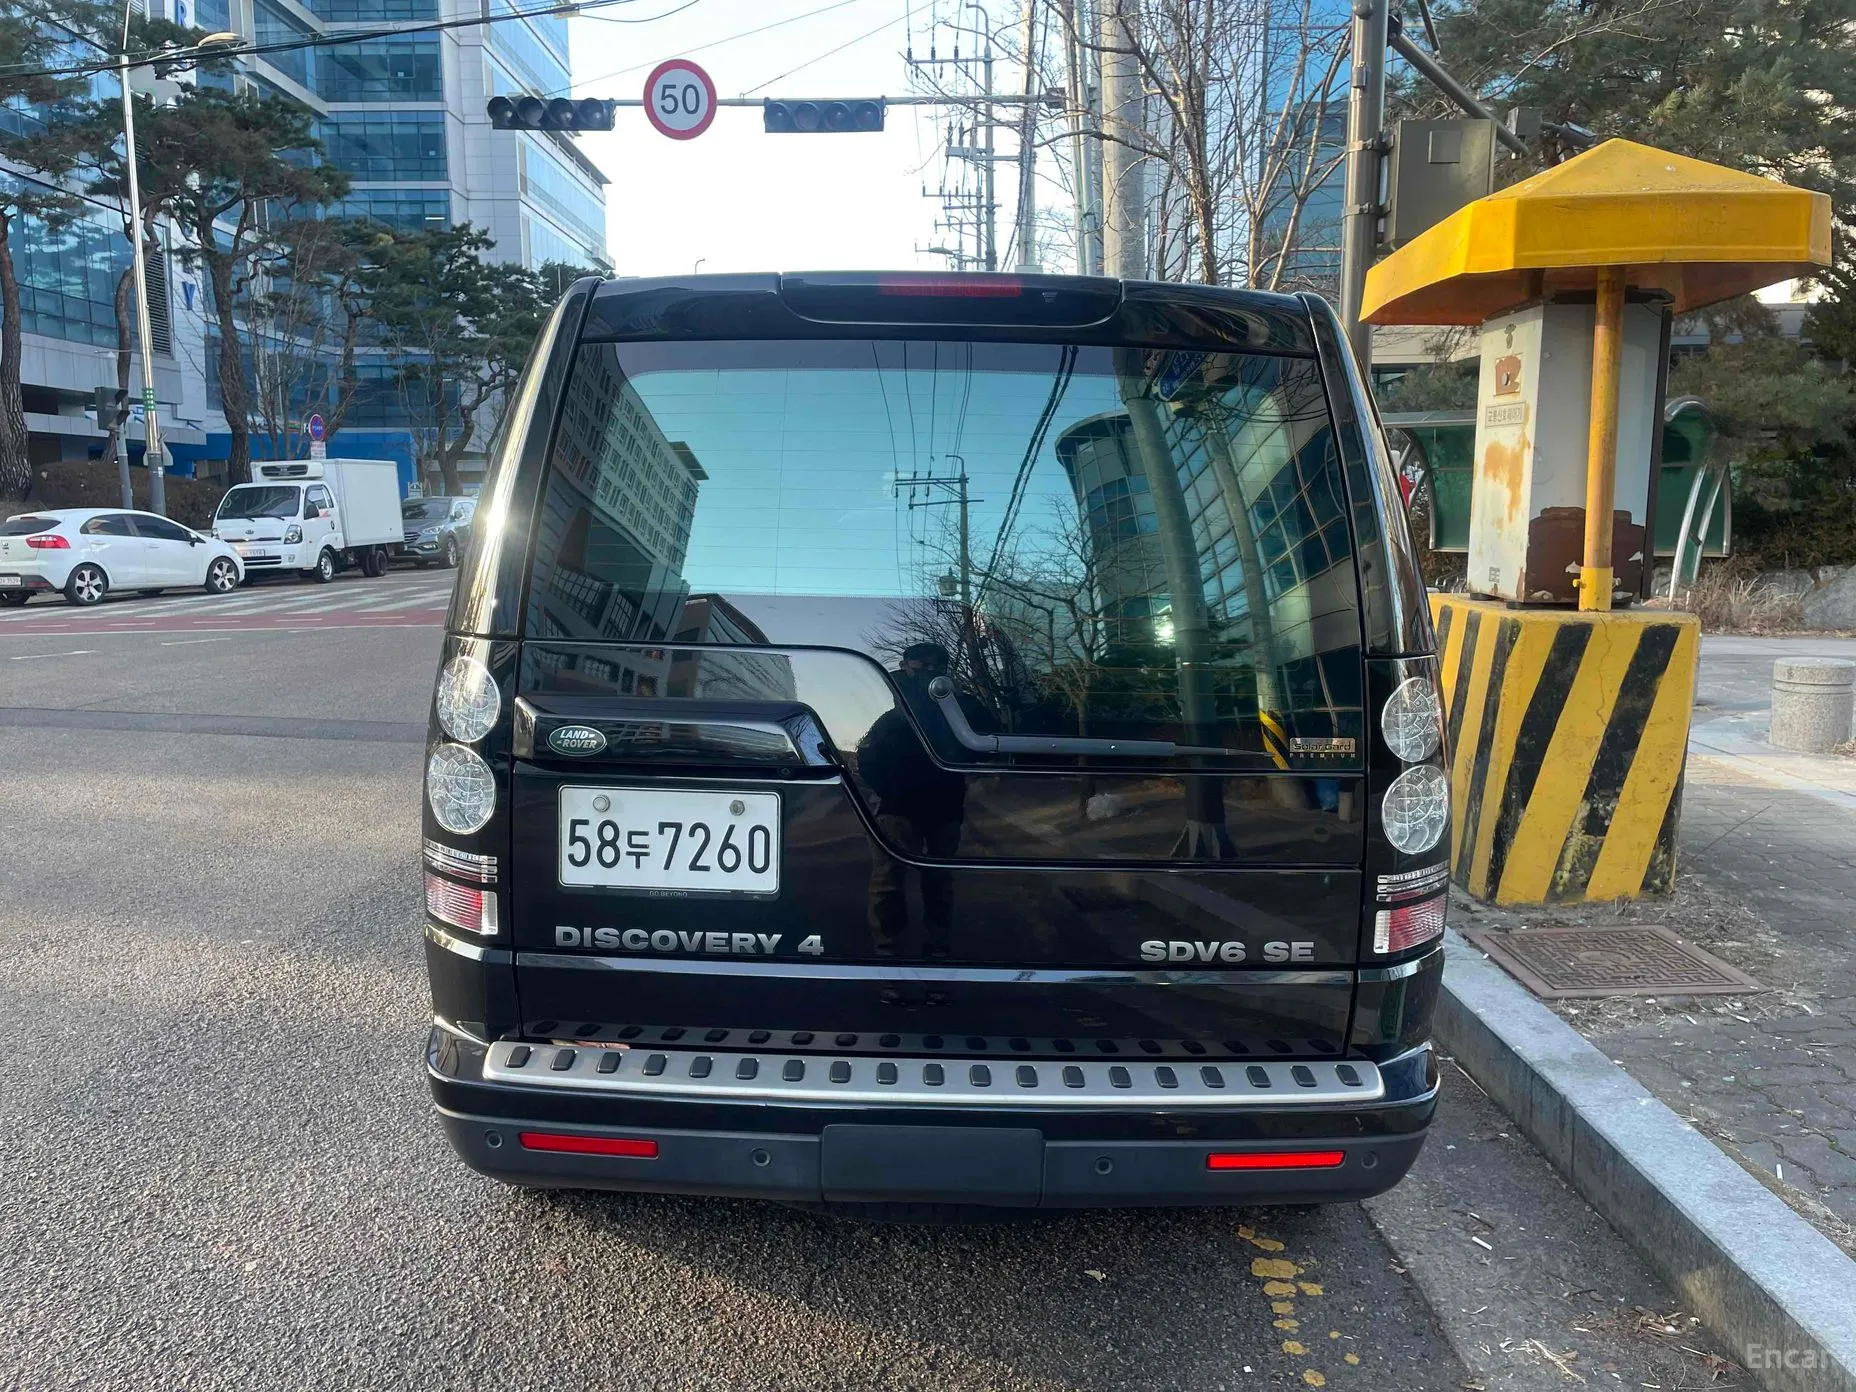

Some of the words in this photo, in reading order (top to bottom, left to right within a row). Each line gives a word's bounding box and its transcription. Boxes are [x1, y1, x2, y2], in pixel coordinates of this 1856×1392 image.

[660, 84, 700, 115] 50
[559, 729, 588, 739] LAND
[562, 739, 598, 749] ROVER
[1294, 742, 1323, 751] Solar
[567, 818, 771, 875] 58두7260
[555, 925, 782, 956] DISCOVERY
[796, 934, 825, 956] 4
[1140, 940, 1247, 963] SDV6
[1263, 941, 1315, 963] SE
